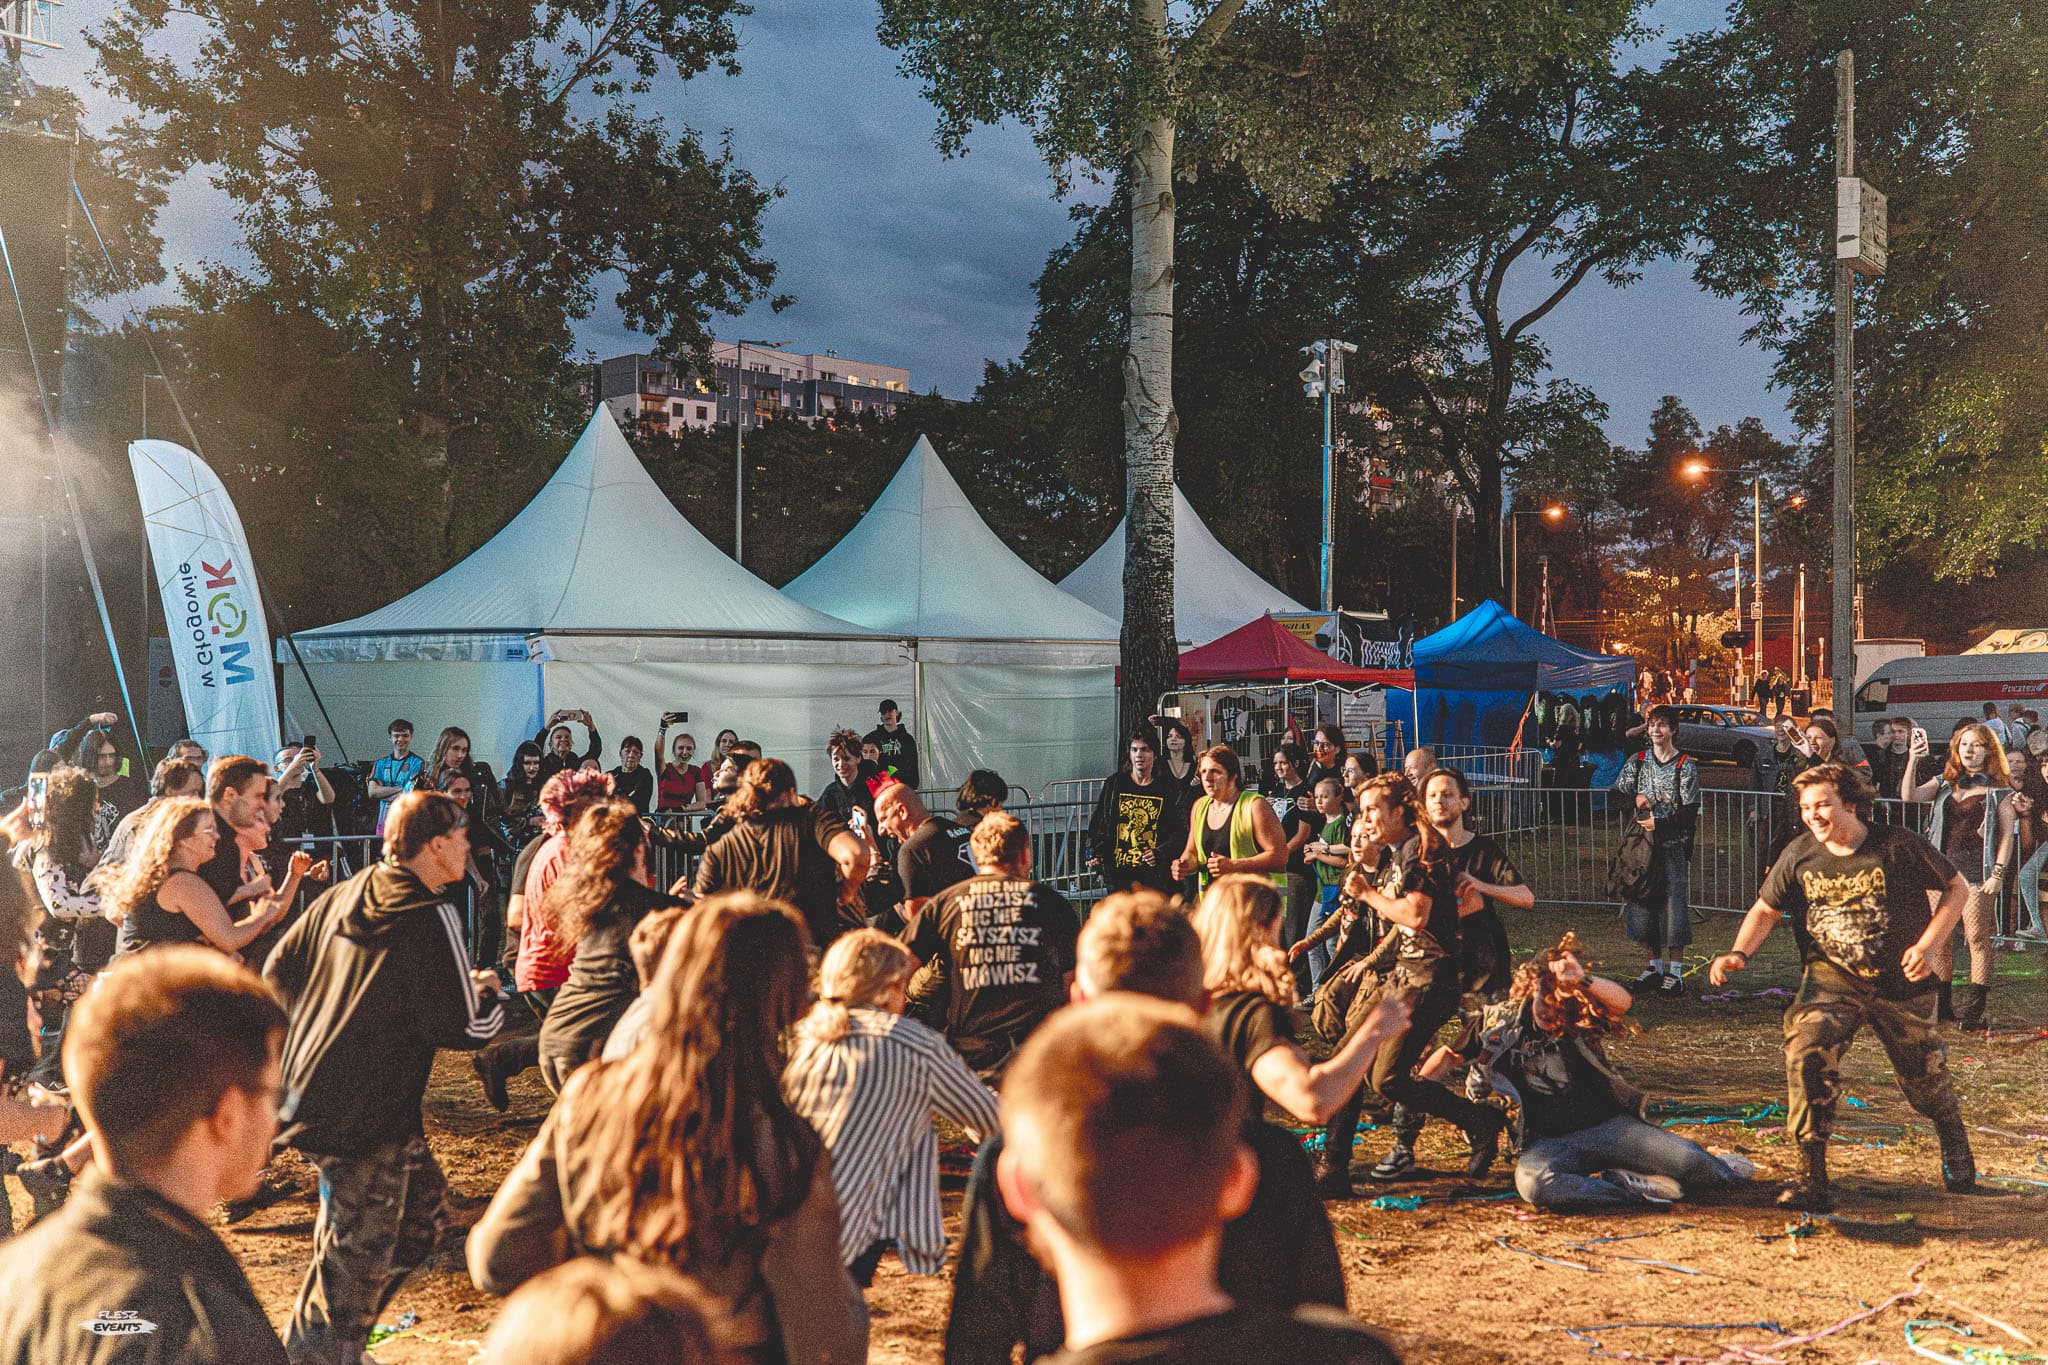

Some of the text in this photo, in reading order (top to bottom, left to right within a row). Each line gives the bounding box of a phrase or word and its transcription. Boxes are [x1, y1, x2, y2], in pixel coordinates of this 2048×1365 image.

[968, 880, 1031, 895] NIC NIE
[961, 907, 1023, 928] NIC NIE
[968, 945, 1022, 965] NIC NIE
